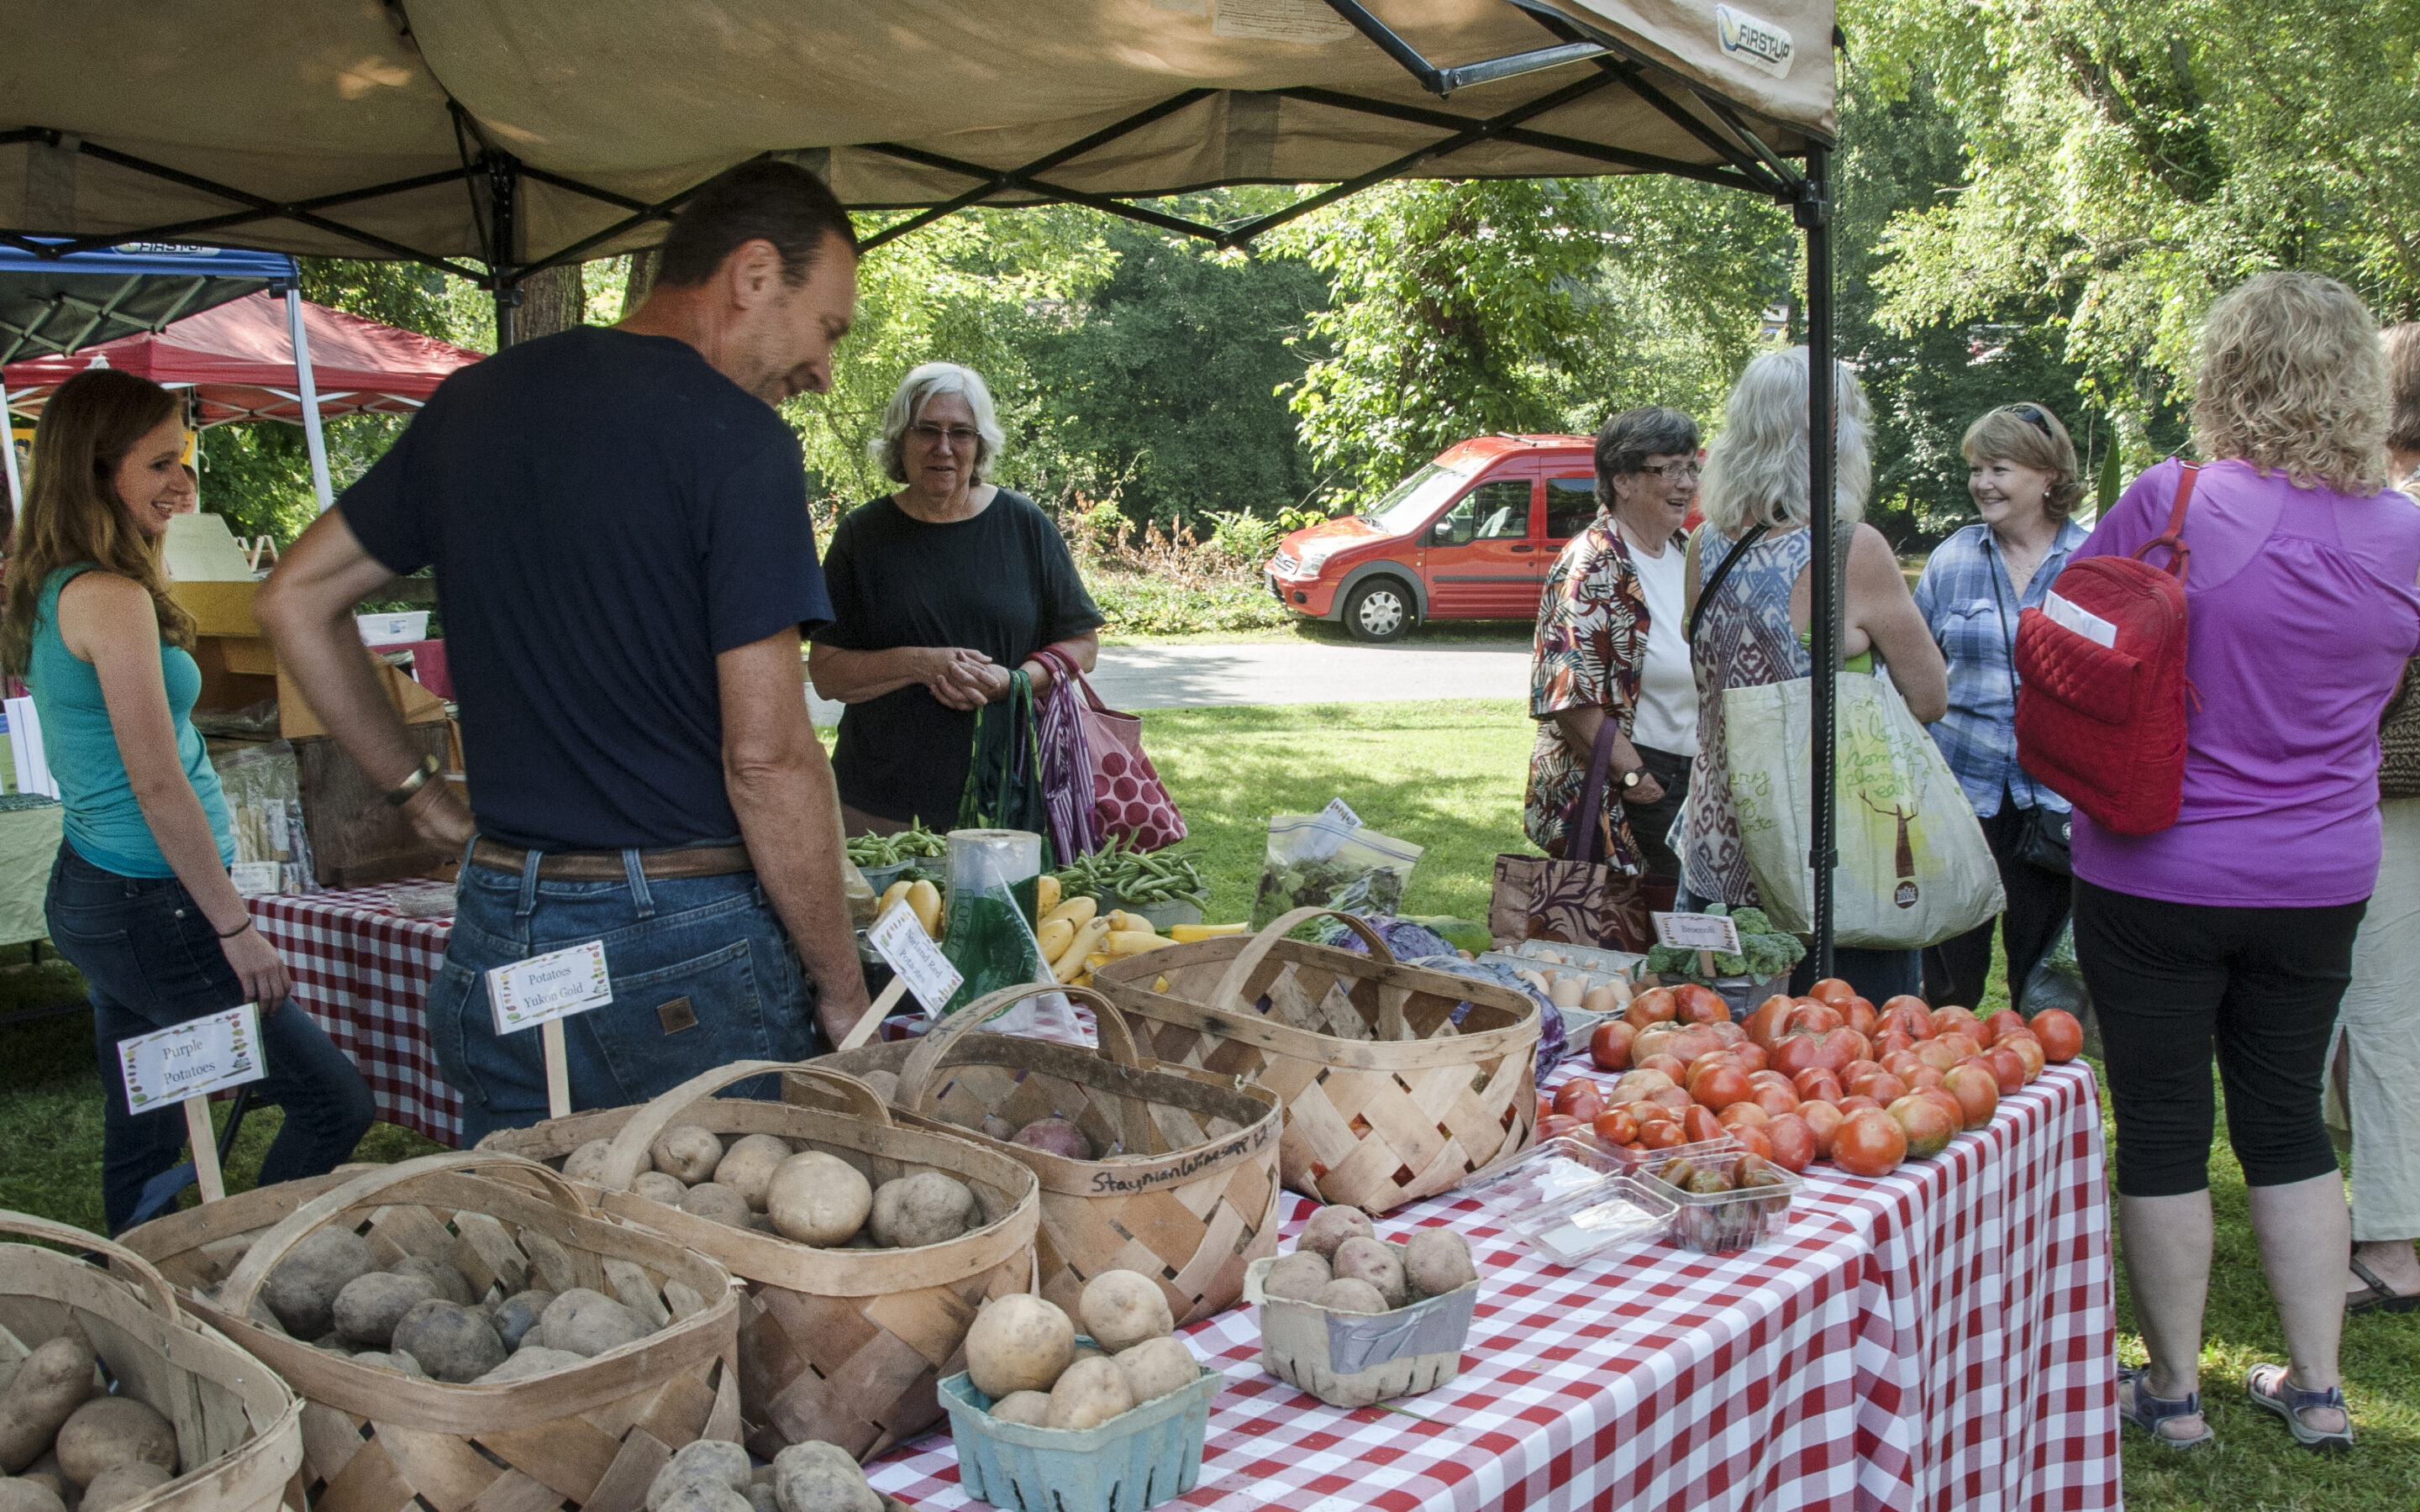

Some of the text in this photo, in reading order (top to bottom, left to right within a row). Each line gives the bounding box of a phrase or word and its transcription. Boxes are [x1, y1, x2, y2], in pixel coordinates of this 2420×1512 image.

[1739, 24, 1791, 60] FIRST-UP
[1681, 925, 1716, 934] Broccoli
[529, 967, 571, 985] Potatoes
[927, 960, 943, 979] Red
[523, 982, 584, 1008] Yukon Gold
[163, 1039, 203, 1059] Purple
[164, 1062, 216, 1084] Potatoes
